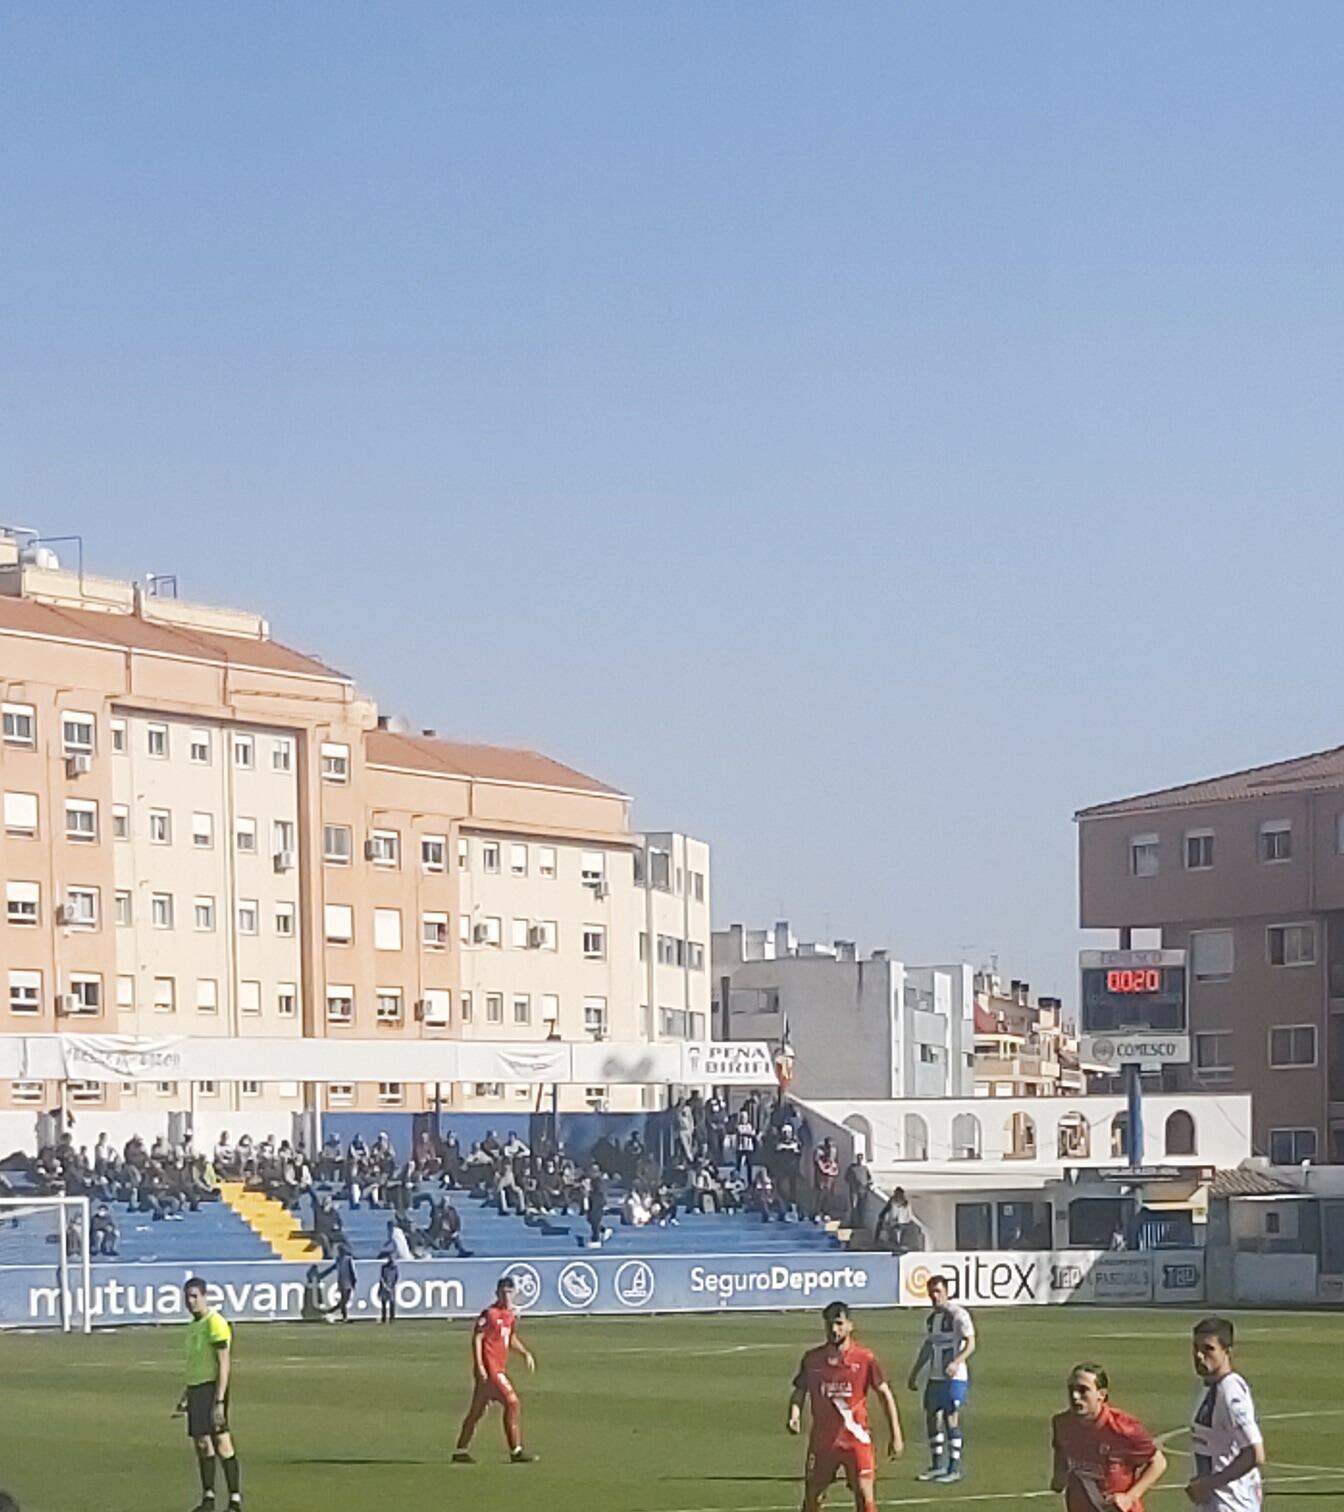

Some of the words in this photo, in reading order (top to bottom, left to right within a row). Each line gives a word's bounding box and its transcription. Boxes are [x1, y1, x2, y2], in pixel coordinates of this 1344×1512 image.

[29, 1269, 464, 1317] mutualevante.com
[690, 1266, 868, 1297] SeguroDeporte
[941, 1256, 1036, 1299] aitex
